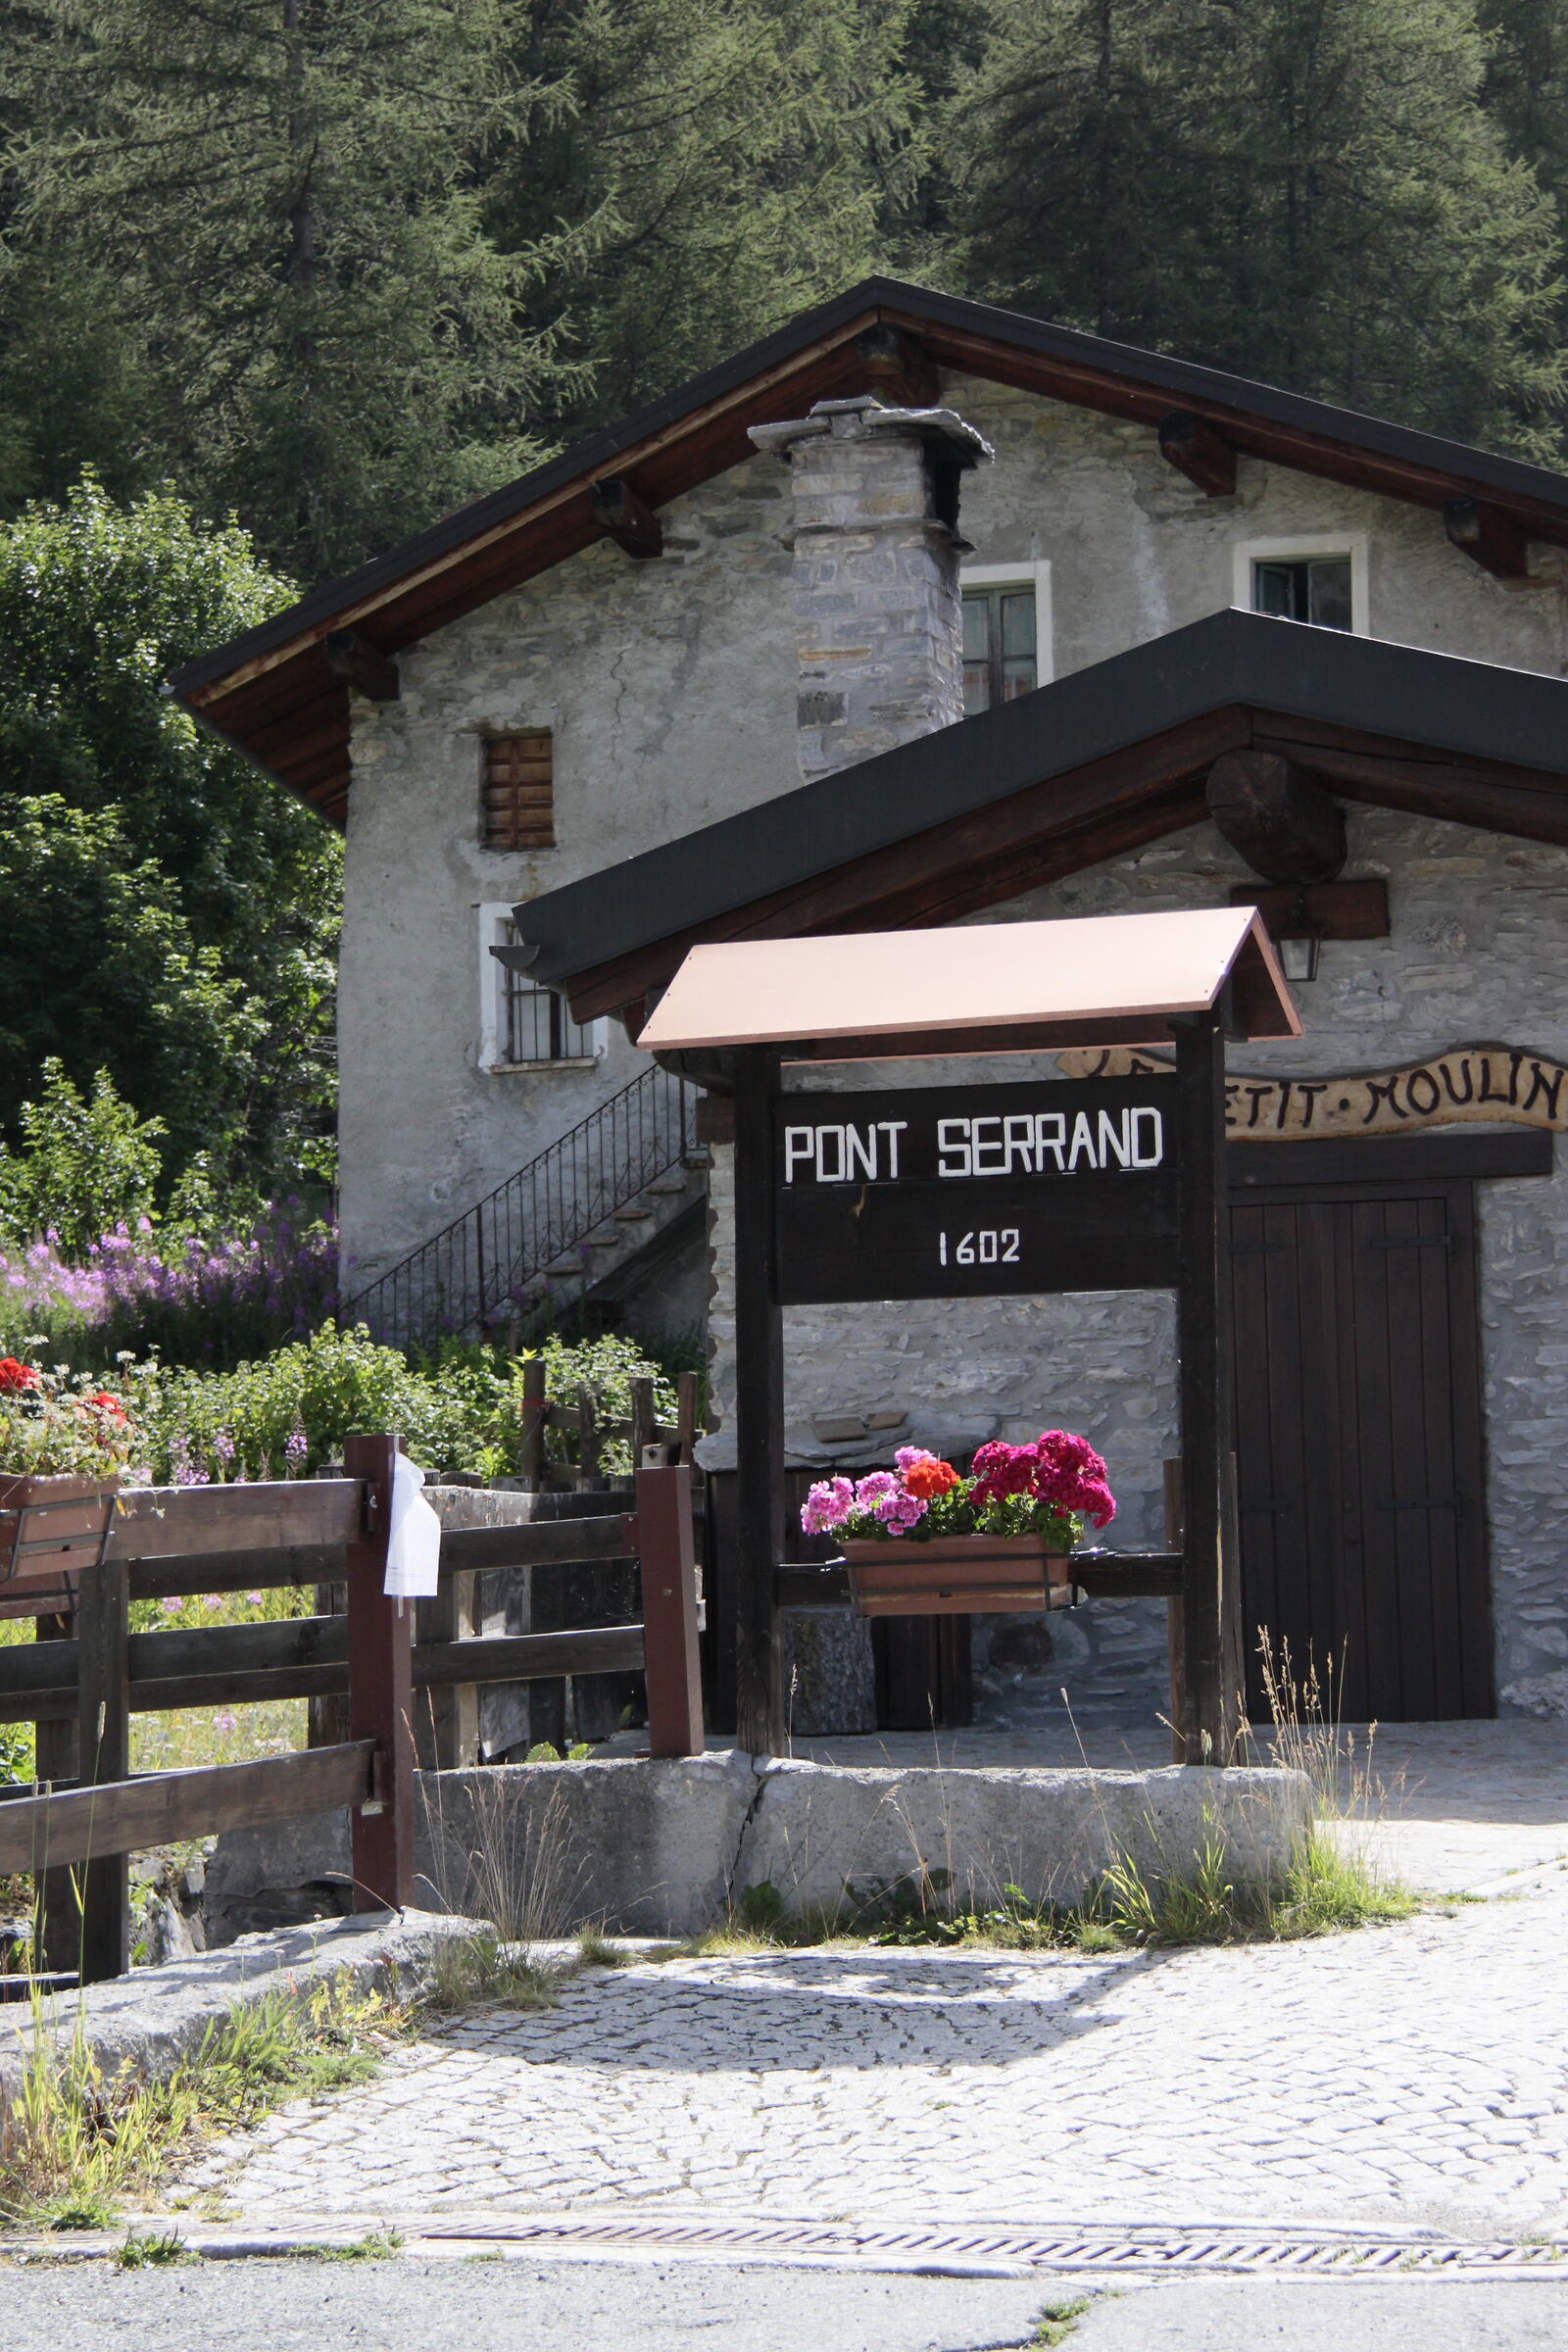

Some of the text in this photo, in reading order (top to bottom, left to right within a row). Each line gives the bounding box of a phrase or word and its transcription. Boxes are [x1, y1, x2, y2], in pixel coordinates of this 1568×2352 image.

[1225, 1053, 1564, 1129] ETIT MOULIN
[784, 1106, 1163, 1183] PONT SERRAND
[939, 1228, 1020, 1266] 1602
